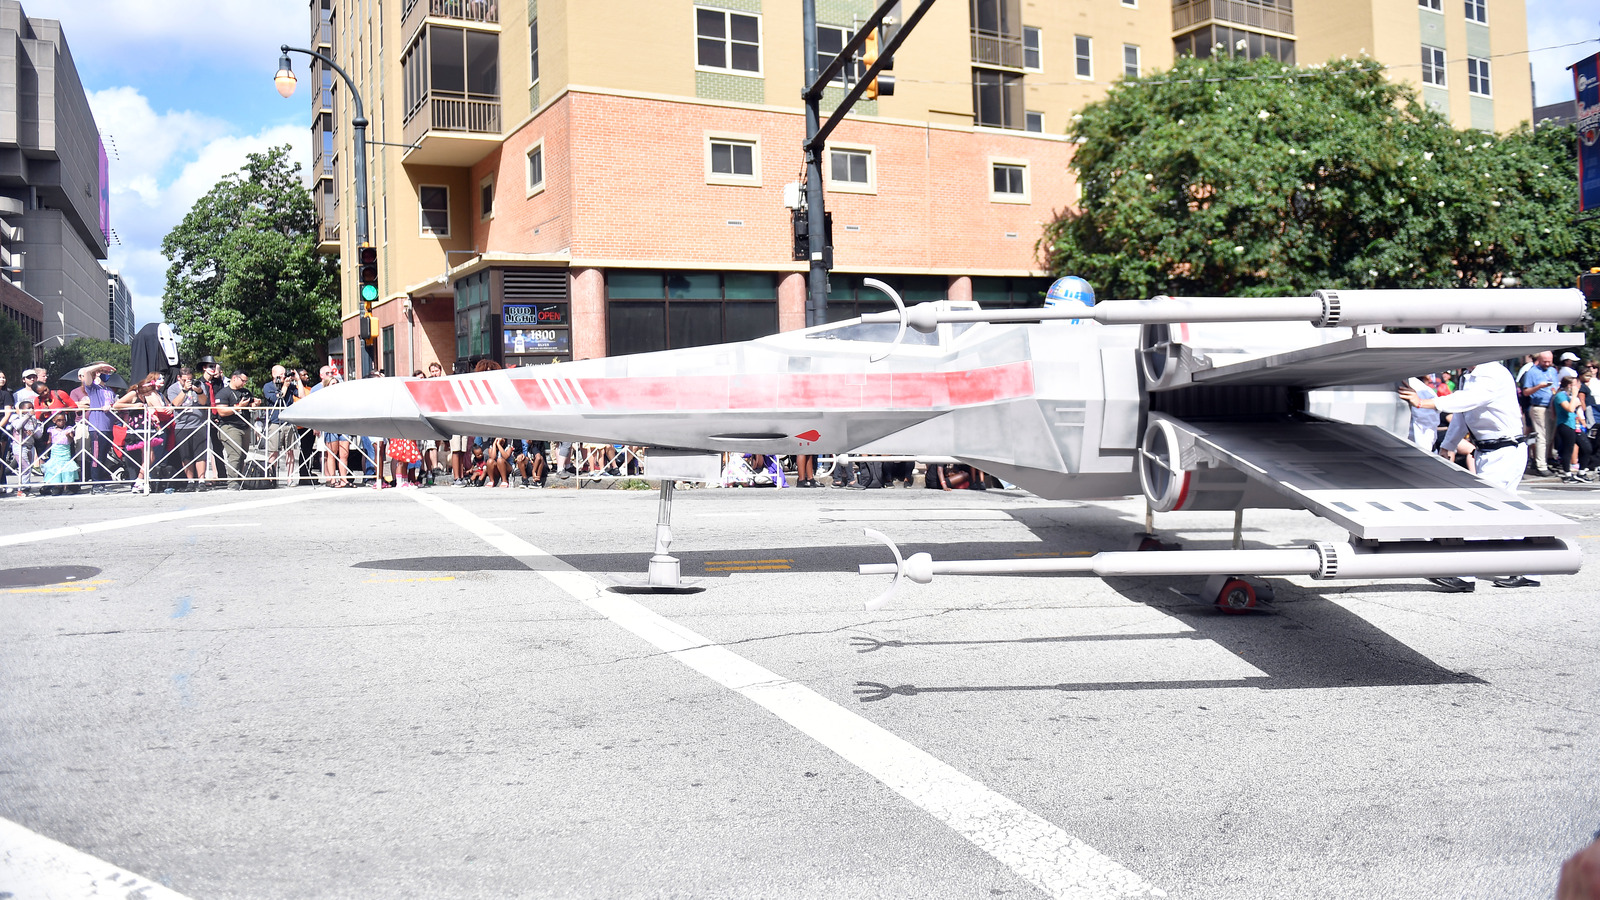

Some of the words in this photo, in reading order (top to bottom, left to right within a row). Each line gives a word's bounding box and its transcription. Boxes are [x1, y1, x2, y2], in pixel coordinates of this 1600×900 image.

[508, 306, 532, 315] BUD
[505, 314, 536, 323] LIGHT
[538, 311, 561, 320] OPEN
[530, 330, 556, 340] 1800
